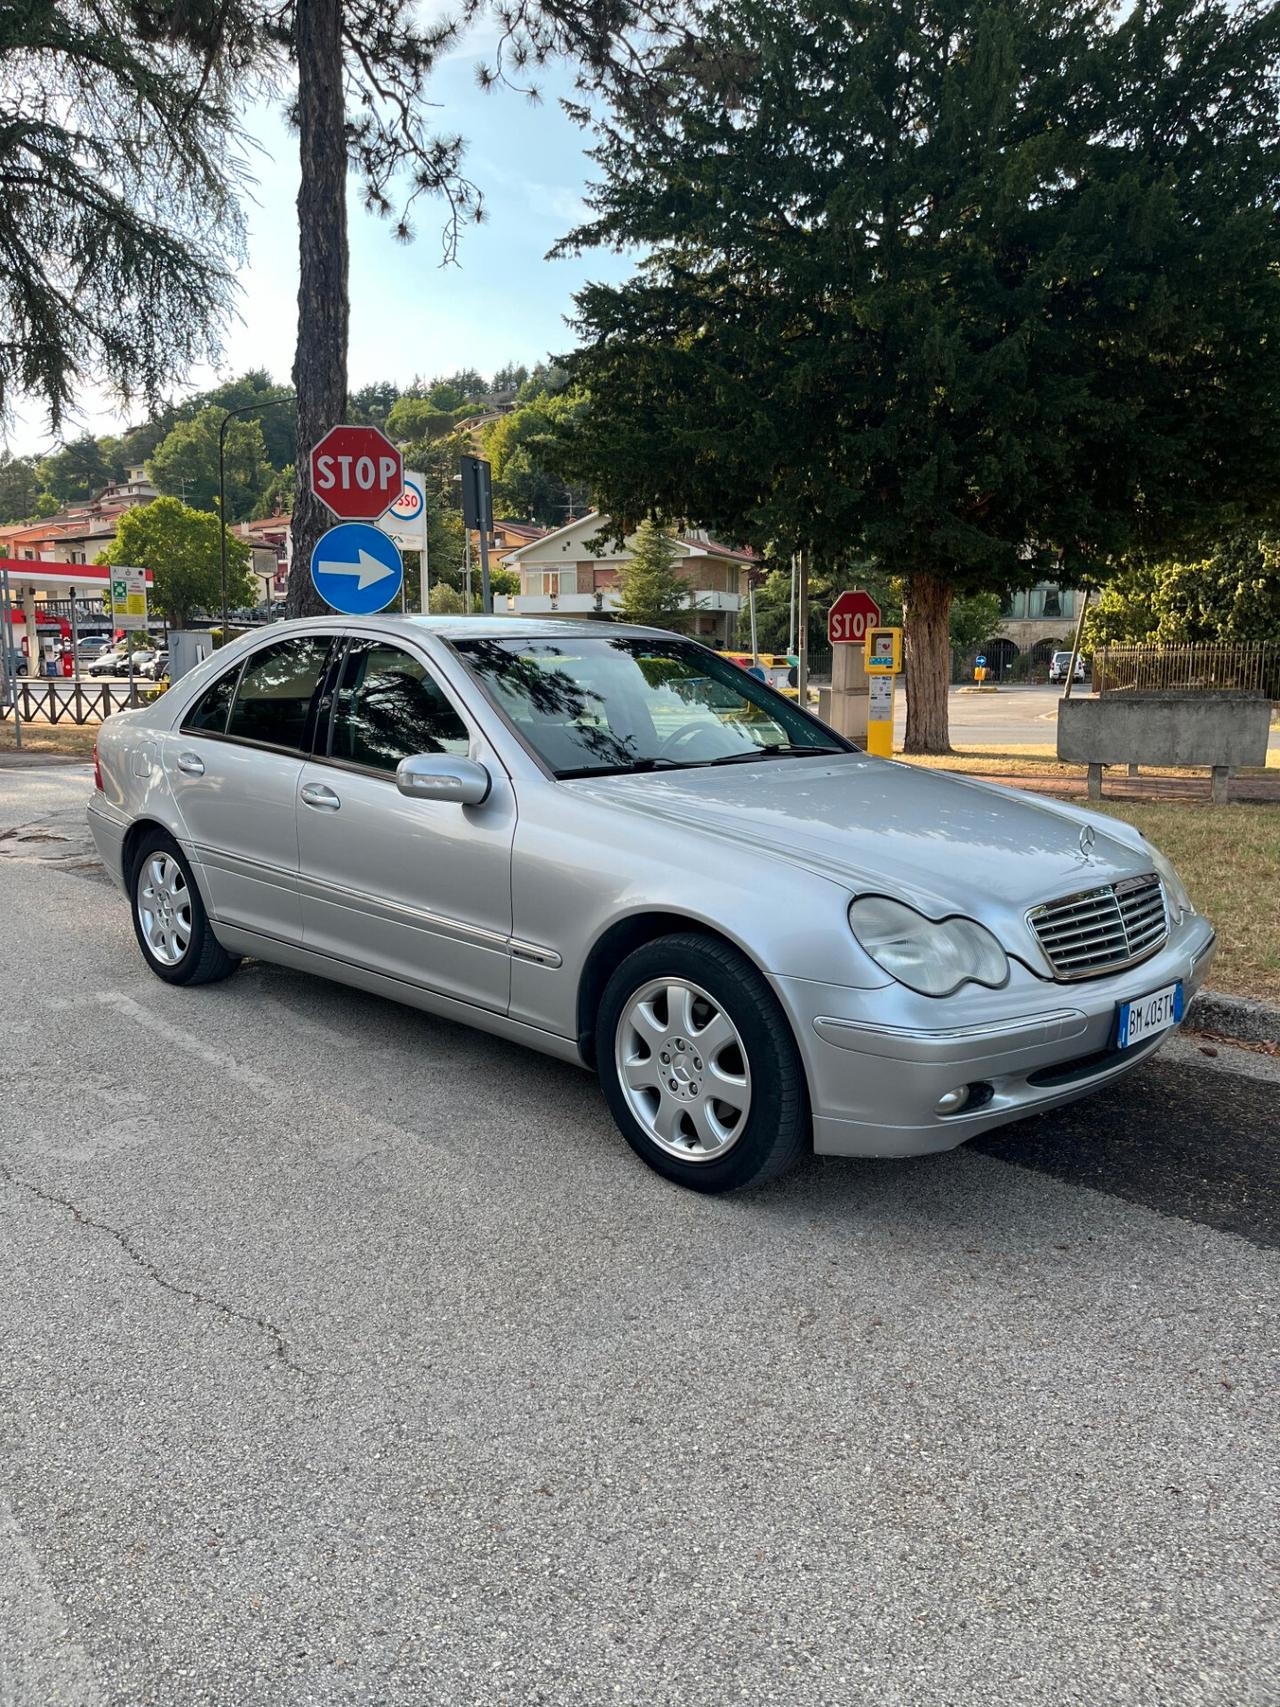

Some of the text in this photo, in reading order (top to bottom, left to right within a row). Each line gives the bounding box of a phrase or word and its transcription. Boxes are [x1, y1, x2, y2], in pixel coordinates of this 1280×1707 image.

[317, 455, 397, 490] STOP
[395, 494, 418, 508] SSO
[832, 612, 877, 638] STOP
